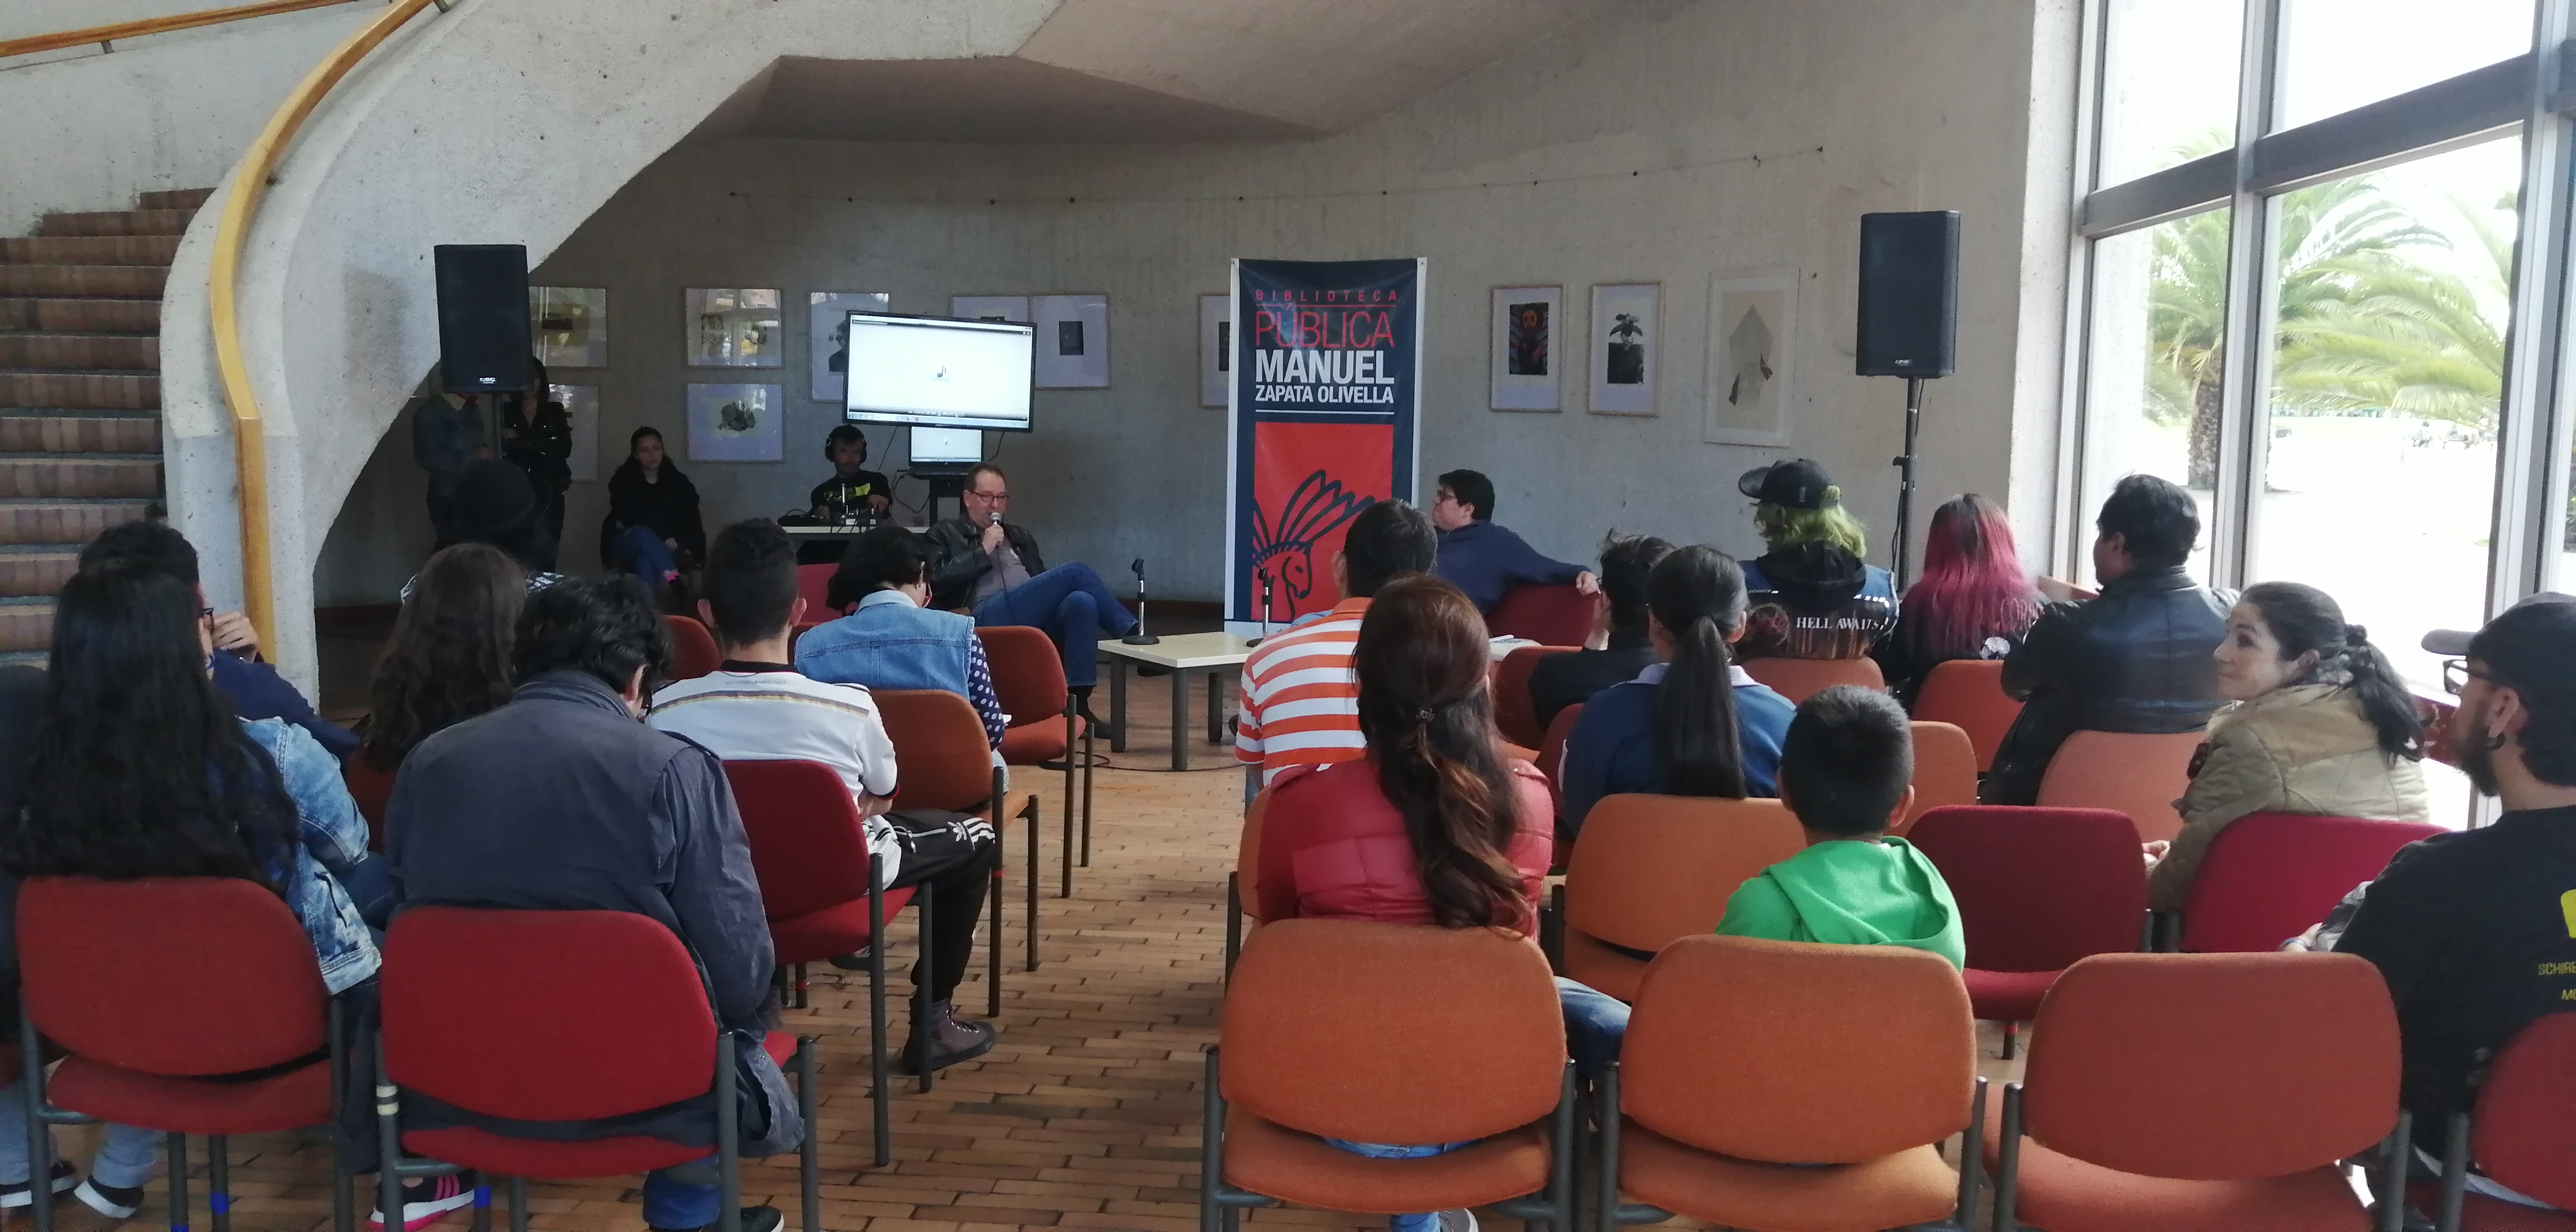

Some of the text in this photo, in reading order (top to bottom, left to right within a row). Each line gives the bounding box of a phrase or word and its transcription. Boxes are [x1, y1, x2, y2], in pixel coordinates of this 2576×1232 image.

[1255, 289, 1397, 302] BIBLIOTECA
[1256, 304, 1395, 348] PÚBLICA
[1255, 349, 1395, 384] MANUEL
[1255, 384, 1394, 404] ZAPATA OLIVELLA
[1796, 617, 1832, 629] HELL
